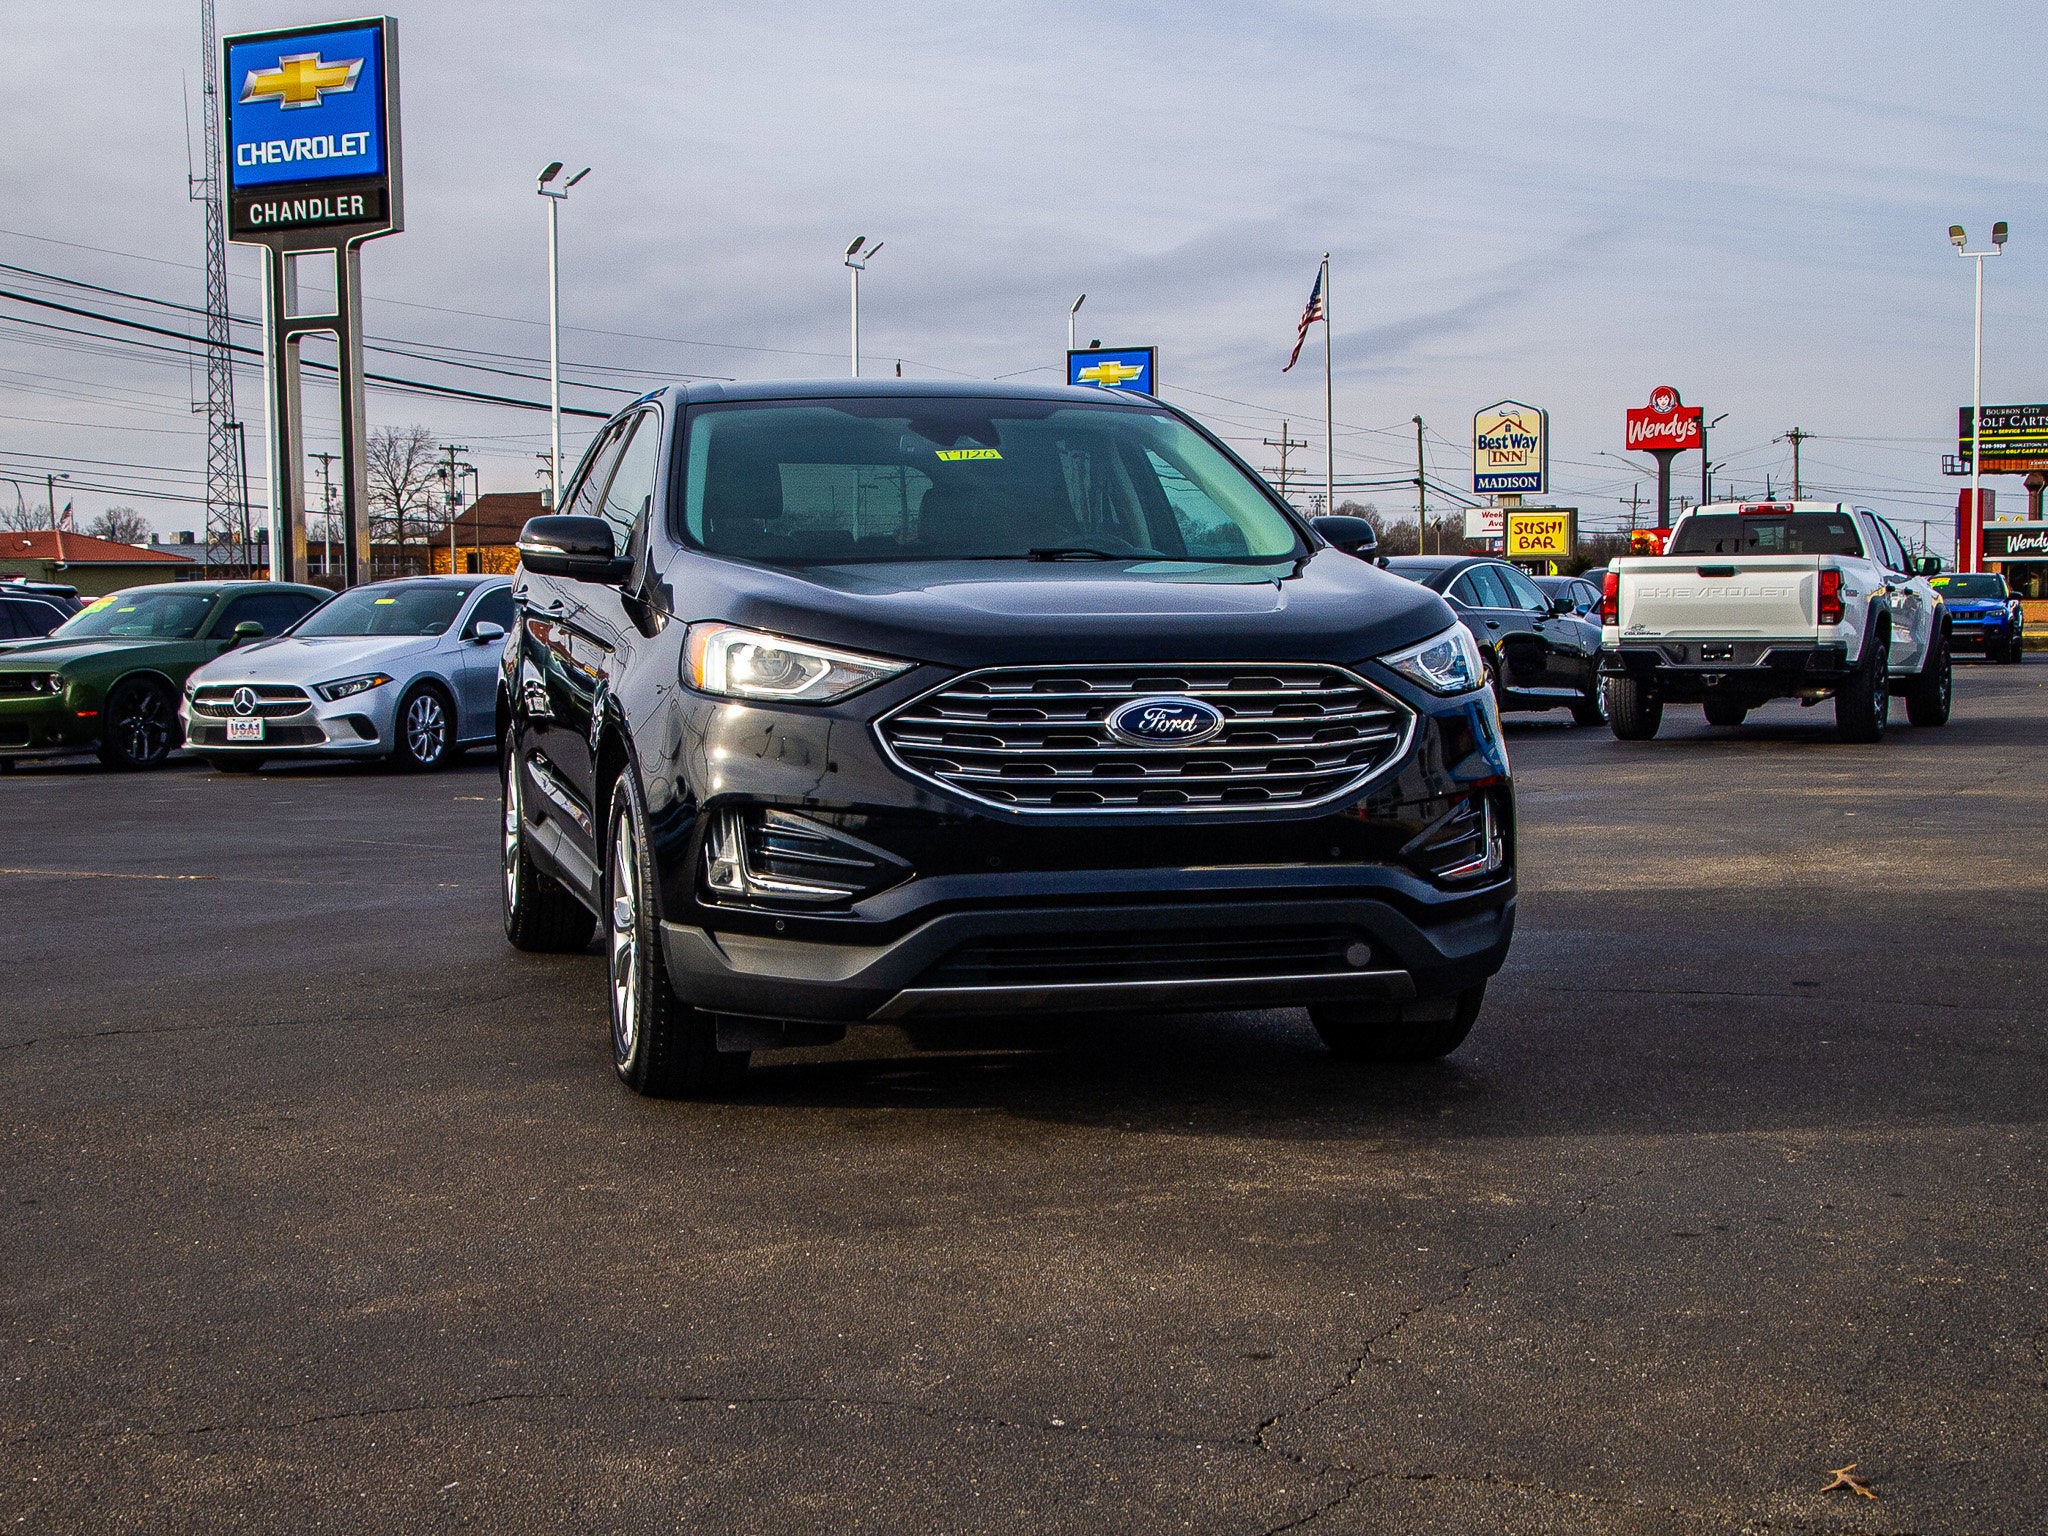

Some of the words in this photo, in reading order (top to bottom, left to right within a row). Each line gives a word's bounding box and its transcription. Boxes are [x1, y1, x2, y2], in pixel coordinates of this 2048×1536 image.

[237, 131, 370, 166] CHEVROLET
[250, 194, 364, 224] CHANDLER
[2022, 406, 2041, 414] CITY
[1628, 413, 1697, 444] Wendy's
[1478, 434, 1508, 450] Best
[1509, 433, 1538, 453] Way
[1491, 450, 1523, 462] INN
[1477, 476, 1538, 489] MADISON
[1514, 521, 1562, 534] SUSHI
[1519, 536, 1556, 549] BAR
[1637, 586, 1795, 599] CHEVROLET
[1138, 707, 1198, 733] Ford
